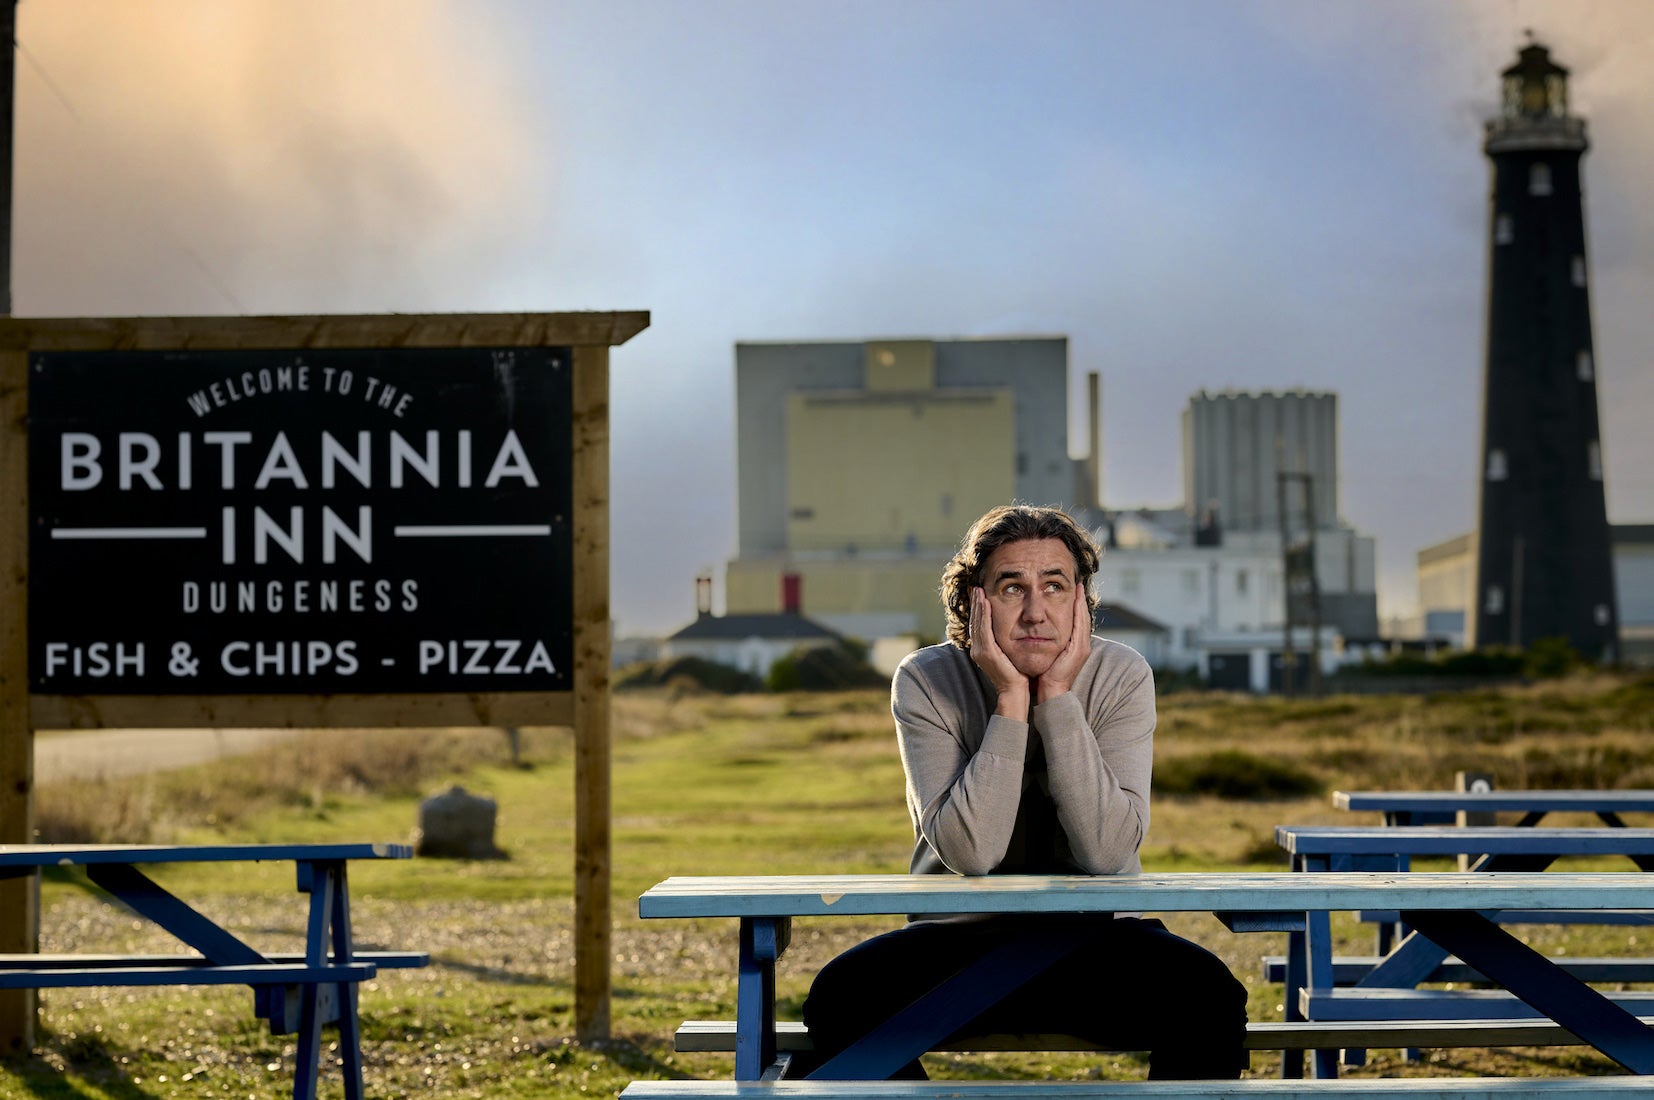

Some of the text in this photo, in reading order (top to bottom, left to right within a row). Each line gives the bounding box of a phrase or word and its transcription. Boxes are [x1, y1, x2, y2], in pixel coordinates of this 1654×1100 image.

[187, 366, 413, 418] WELCOME TO THE
[60, 430, 539, 491] BRITANNIA
[222, 506, 373, 565] INN
[183, 580, 419, 613] DUNGENESS
[168, 641, 200, 677] &
[221, 640, 360, 676] CHIPS
[419, 639, 556, 675] PIZZA
